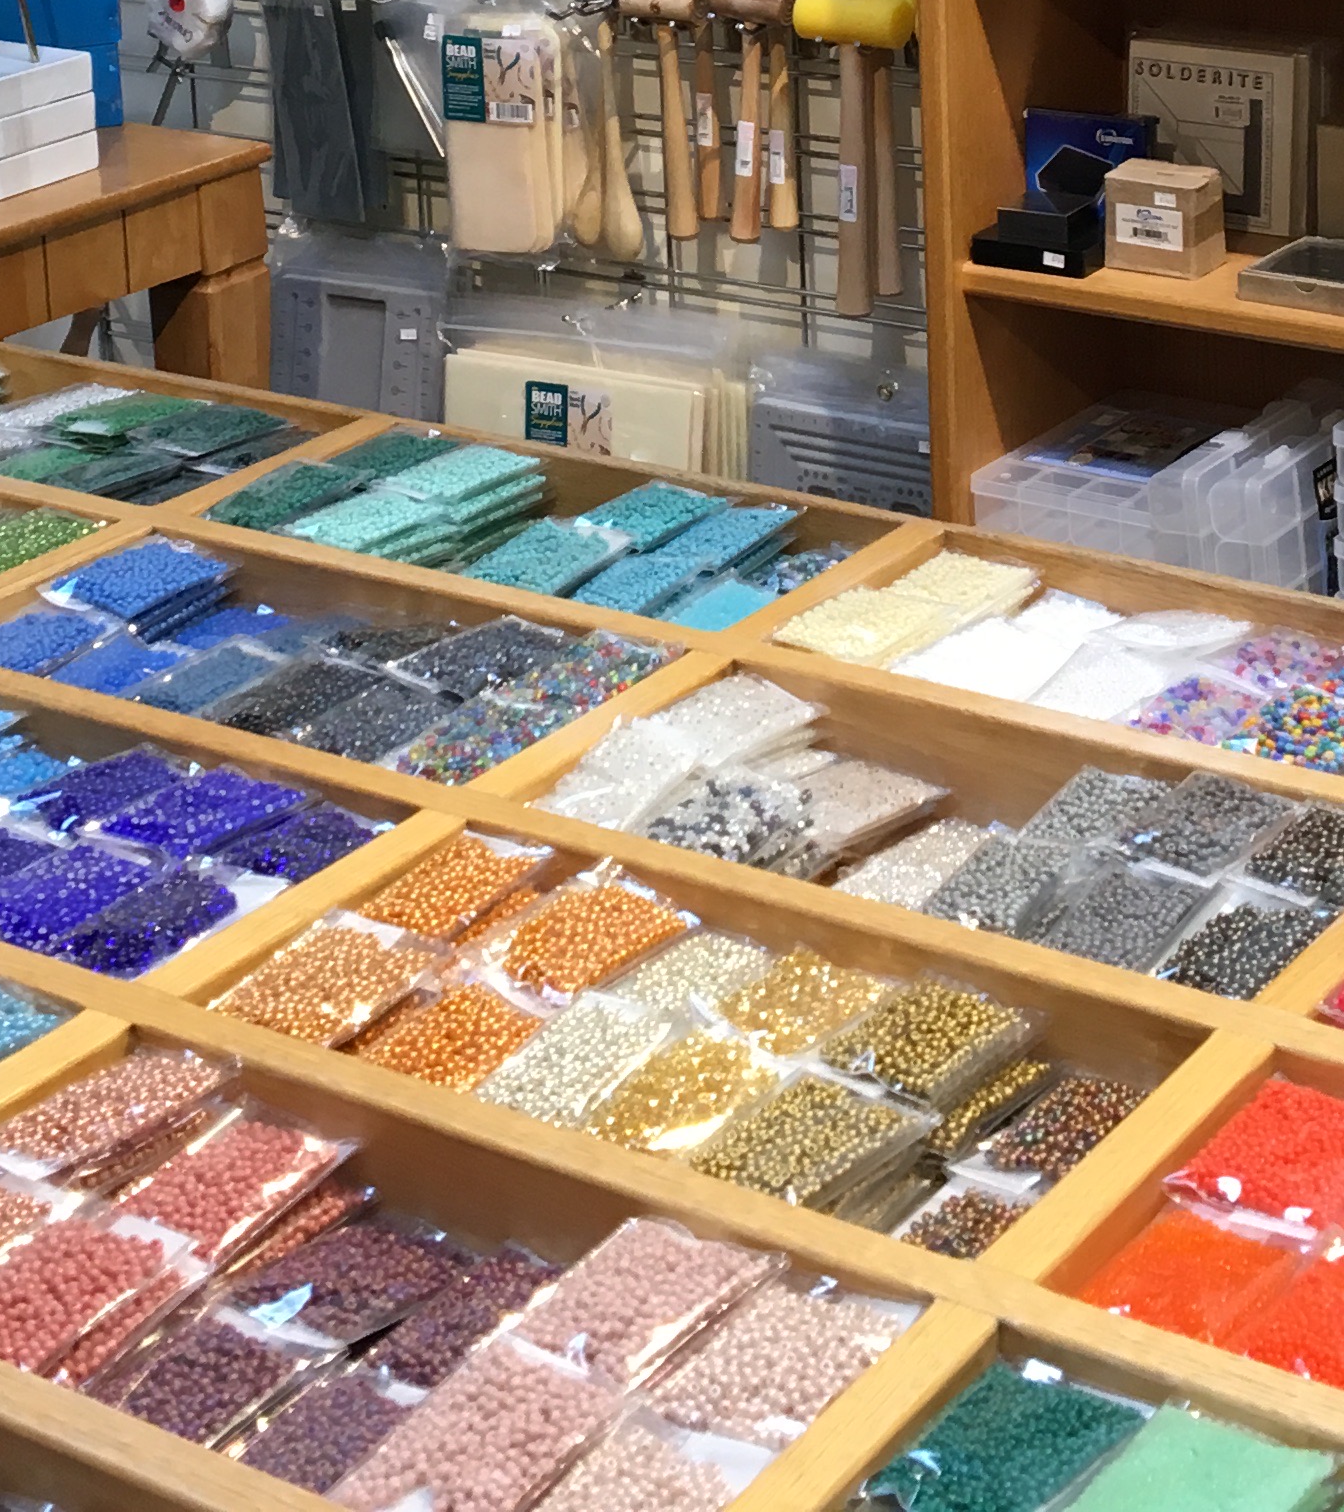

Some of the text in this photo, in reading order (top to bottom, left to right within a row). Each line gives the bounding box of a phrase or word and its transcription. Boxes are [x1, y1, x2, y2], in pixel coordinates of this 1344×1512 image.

[445, 43, 477, 57] BEAD
[445, 56, 478, 70] SMITH
[1134, 60, 1264, 90] SOLDERITE
[531, 390, 563, 405] BEAD
[531, 402, 563, 417] SMITH
